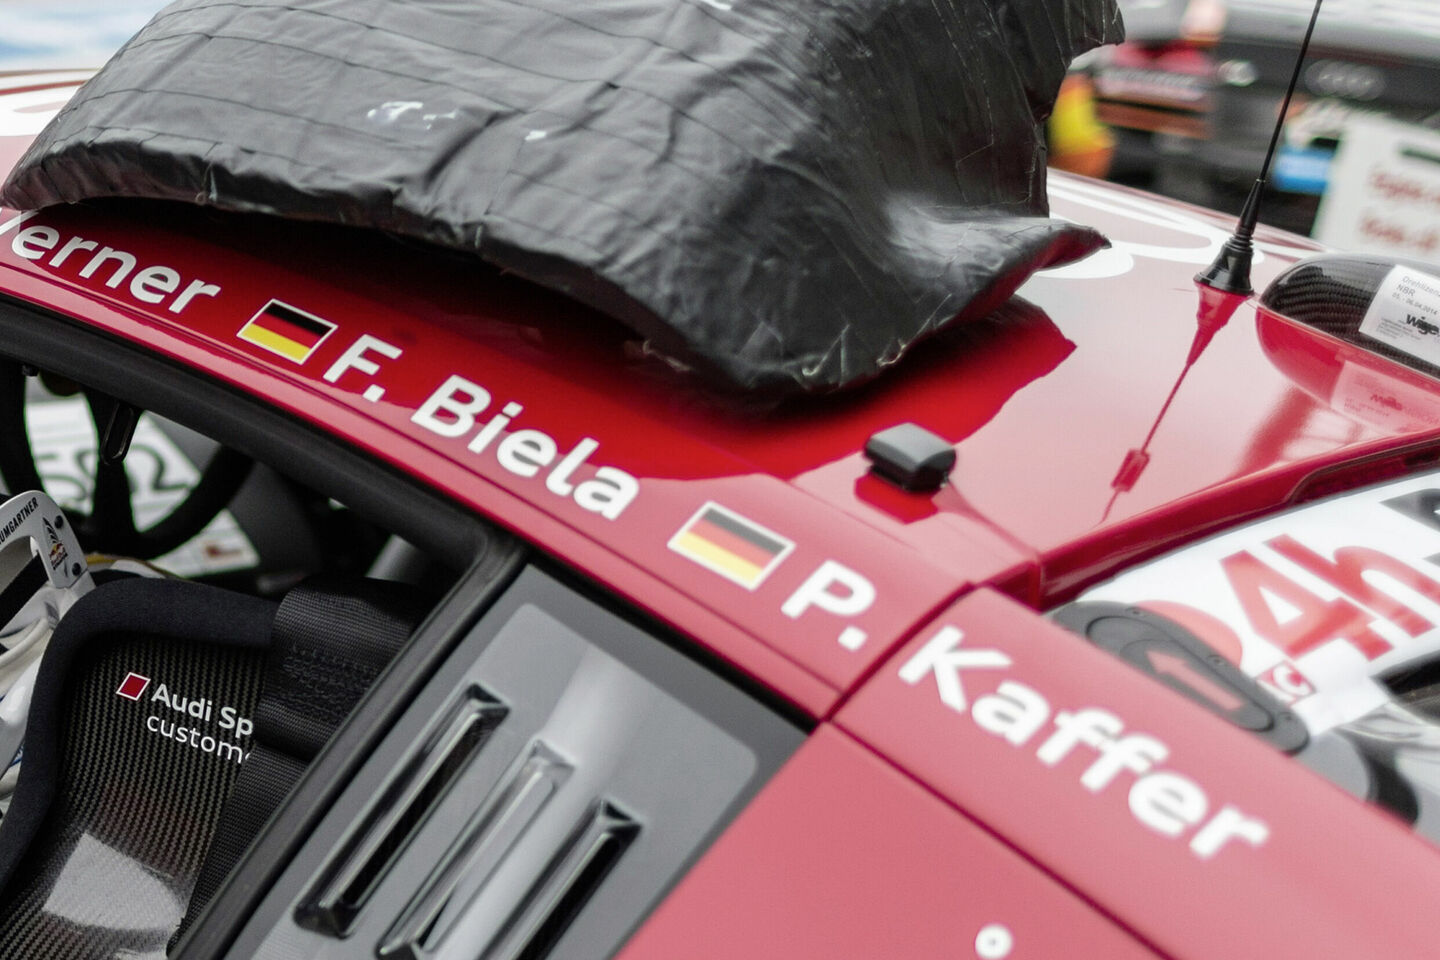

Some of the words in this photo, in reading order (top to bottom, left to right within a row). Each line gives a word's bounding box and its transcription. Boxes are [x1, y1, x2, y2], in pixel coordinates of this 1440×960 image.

[1396, 284, 1416, 297] NBR
[322, 334, 403, 403] F.
[410, 374, 640, 522] Biela
[151, 683, 212, 722] Audi
[779, 559, 876, 652] P.
[897, 626, 1270, 859] Kaffer
[146, 715, 252, 765] custom
